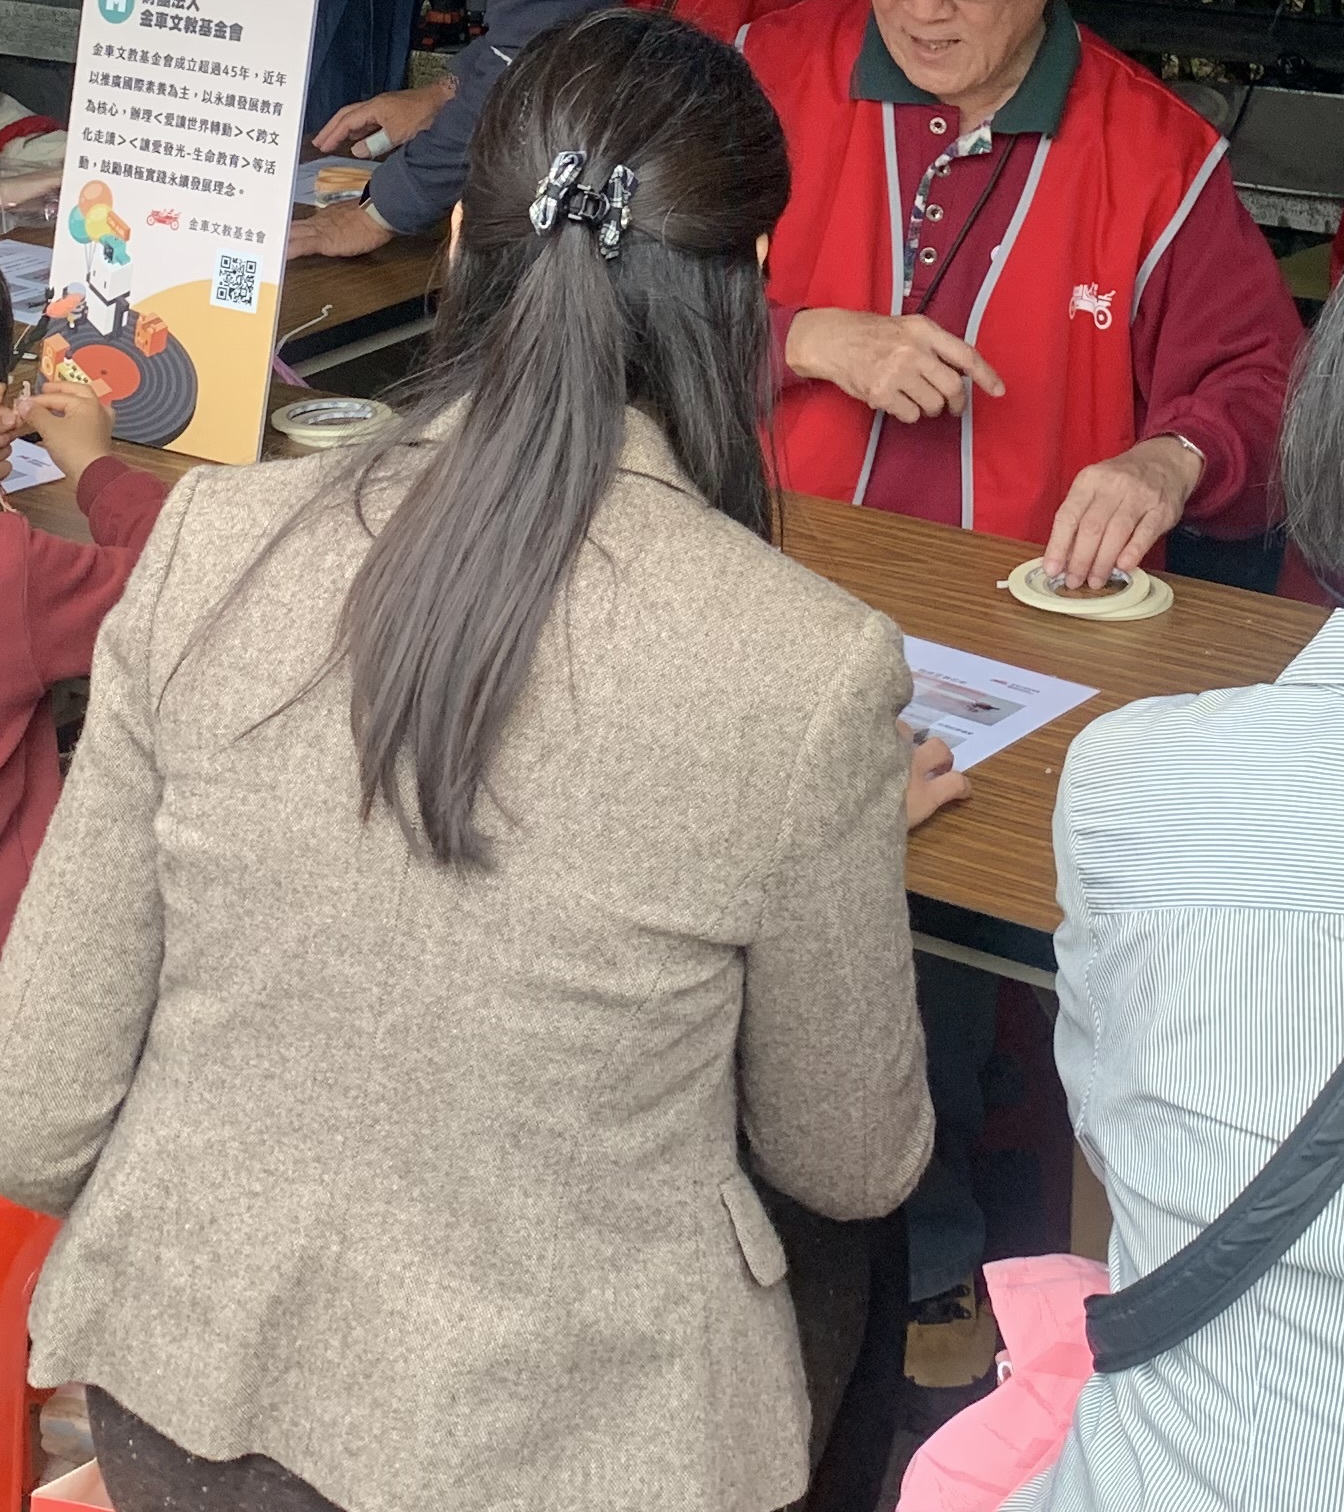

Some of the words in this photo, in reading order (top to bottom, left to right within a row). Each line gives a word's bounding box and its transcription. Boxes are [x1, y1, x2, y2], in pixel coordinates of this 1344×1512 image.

[139, 9, 244, 42] 金車文教基金會
[188, 217, 266, 244] 金車文教基金會
